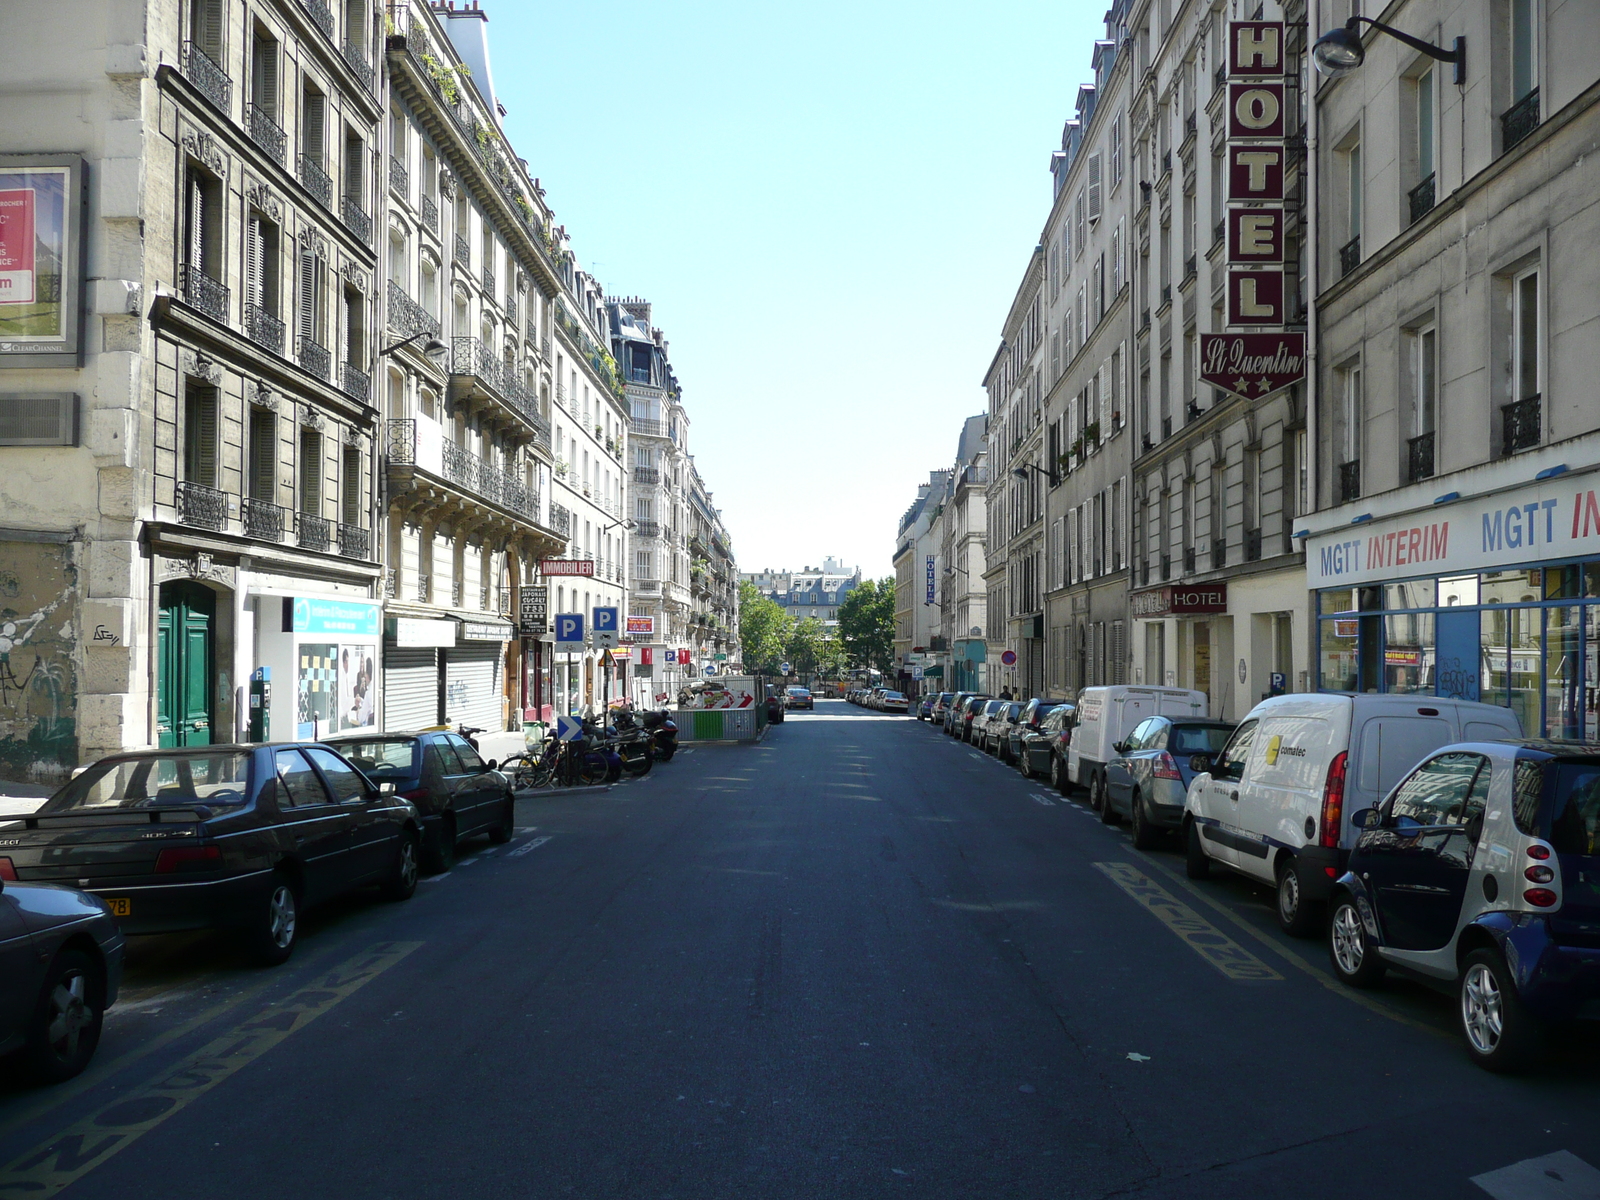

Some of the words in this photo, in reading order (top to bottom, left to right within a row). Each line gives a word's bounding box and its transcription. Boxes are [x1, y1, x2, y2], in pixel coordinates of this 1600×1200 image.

[1235, 27, 1280, 317] HOTEL
[1203, 337, 1228, 374] St
[1228, 338, 1304, 374] Quentin
[1482, 498, 1557, 552] MGTT
[1571, 490, 1600, 539] IN
[1320, 539, 1361, 577] MGTT
[1366, 521, 1449, 570] INTERIM
[543, 562, 592, 574] IMMOBILIER
[926, 555, 934, 593] HOTEL
[1174, 592, 1227, 605] HOTEL
[600, 611, 611, 627] P
[563, 619, 576, 637] P
[255, 670, 262, 680] P
[1273, 673, 1282, 685] P
[1280, 746, 1306, 757] comatec
